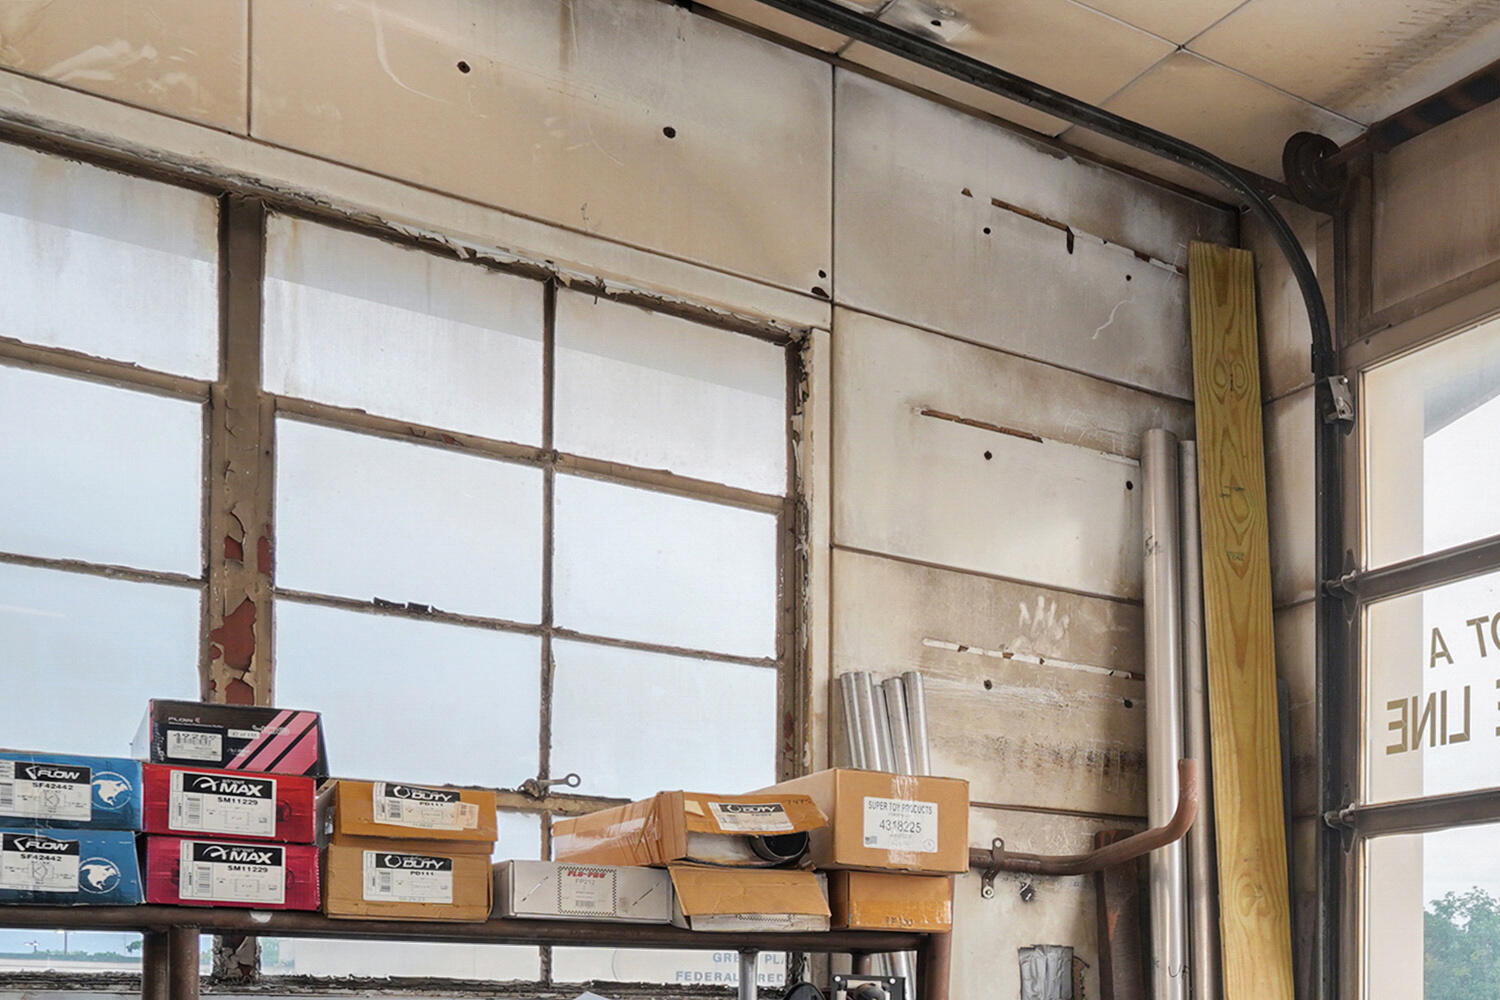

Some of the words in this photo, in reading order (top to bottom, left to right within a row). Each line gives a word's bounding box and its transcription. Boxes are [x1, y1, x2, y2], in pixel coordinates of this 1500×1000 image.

[37, 769, 80, 780] FLOW
[219, 782, 264, 797] MAX
[217, 796, 259, 806] SM11229
[411, 792, 452, 802] DUTY
[25, 840, 69, 851] FLOW
[229, 851, 273, 865] MAX
[227, 864, 269, 873] SM11229
[402, 860, 444, 870] DUTY
